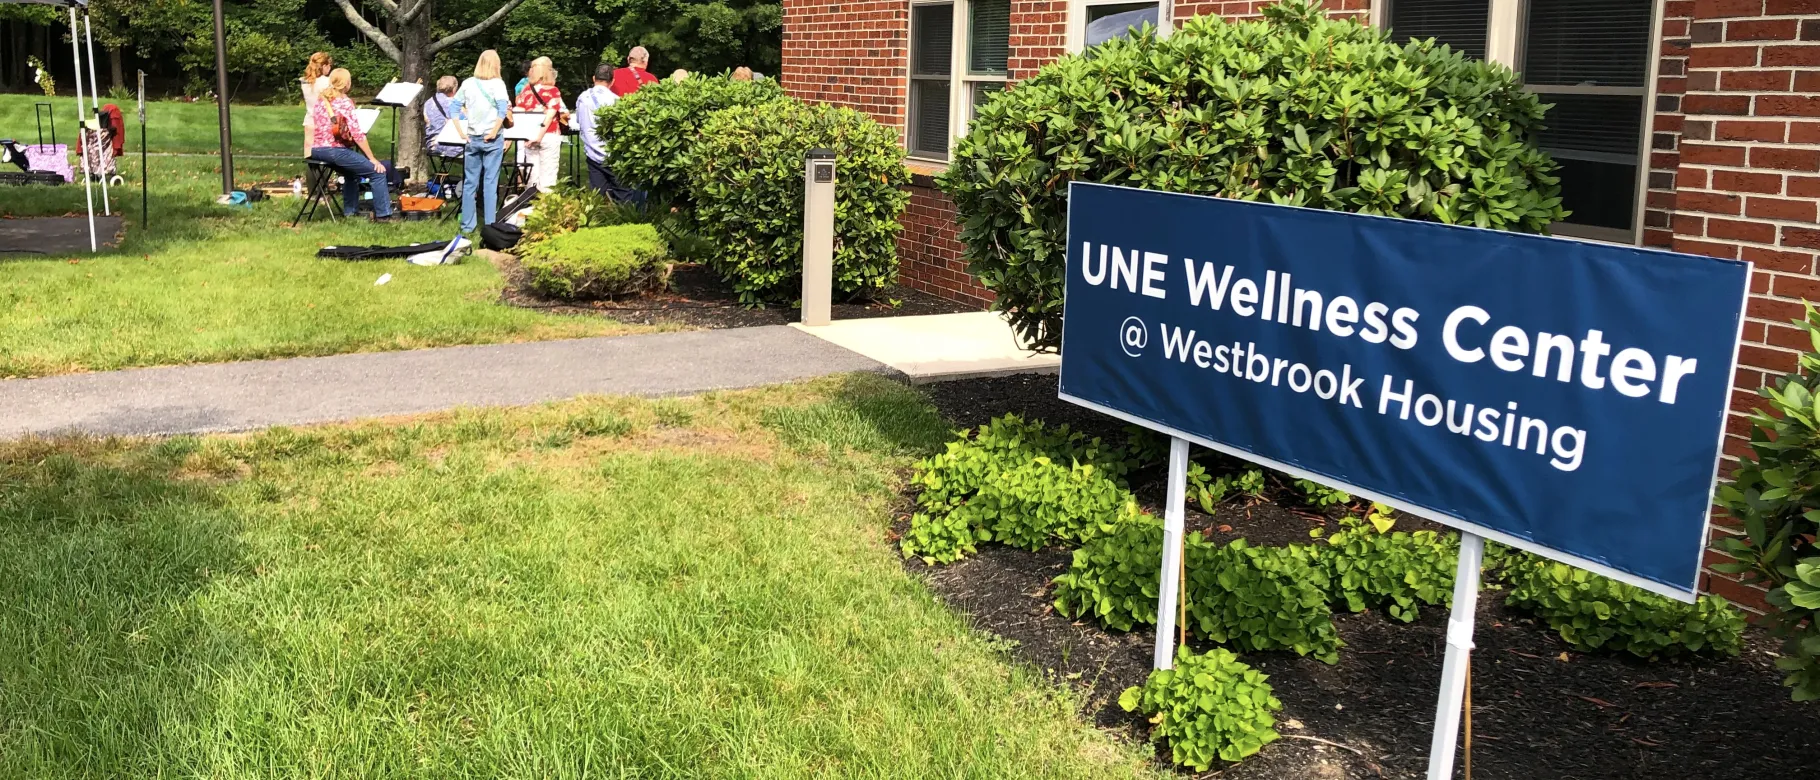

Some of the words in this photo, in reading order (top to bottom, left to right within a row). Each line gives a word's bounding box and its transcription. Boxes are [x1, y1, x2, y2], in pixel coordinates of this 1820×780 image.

[1082, 241, 1168, 299] UNE
[1183, 258, 1419, 350] Wellness
[1442, 305, 1698, 404] Center
[1119, 316, 1148, 357] @
[1160, 322, 1364, 409] Westbrook
[1378, 374, 1587, 472] Housing
